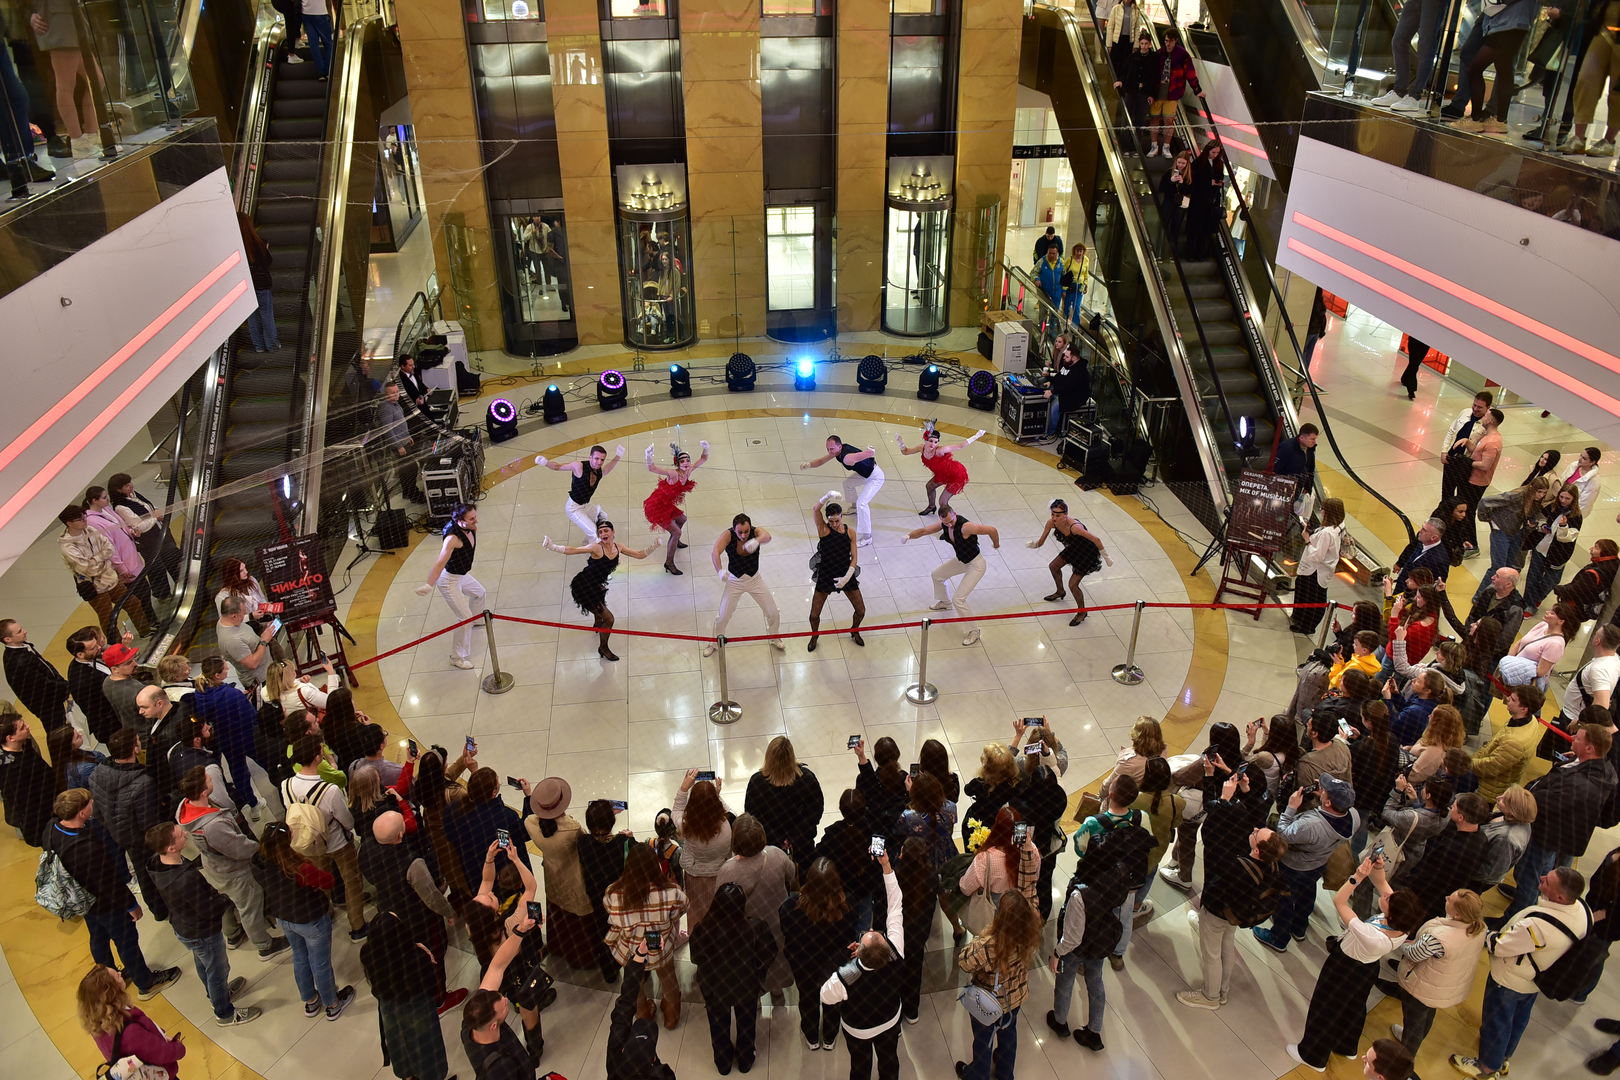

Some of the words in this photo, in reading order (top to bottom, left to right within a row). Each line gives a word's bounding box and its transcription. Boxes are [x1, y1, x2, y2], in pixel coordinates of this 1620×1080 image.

[1241, 481, 1269, 491] ОПЕРЕТА.
[1260, 492, 1290, 502] MUSICALS
[271, 574, 323, 594] ЧИКАГО
